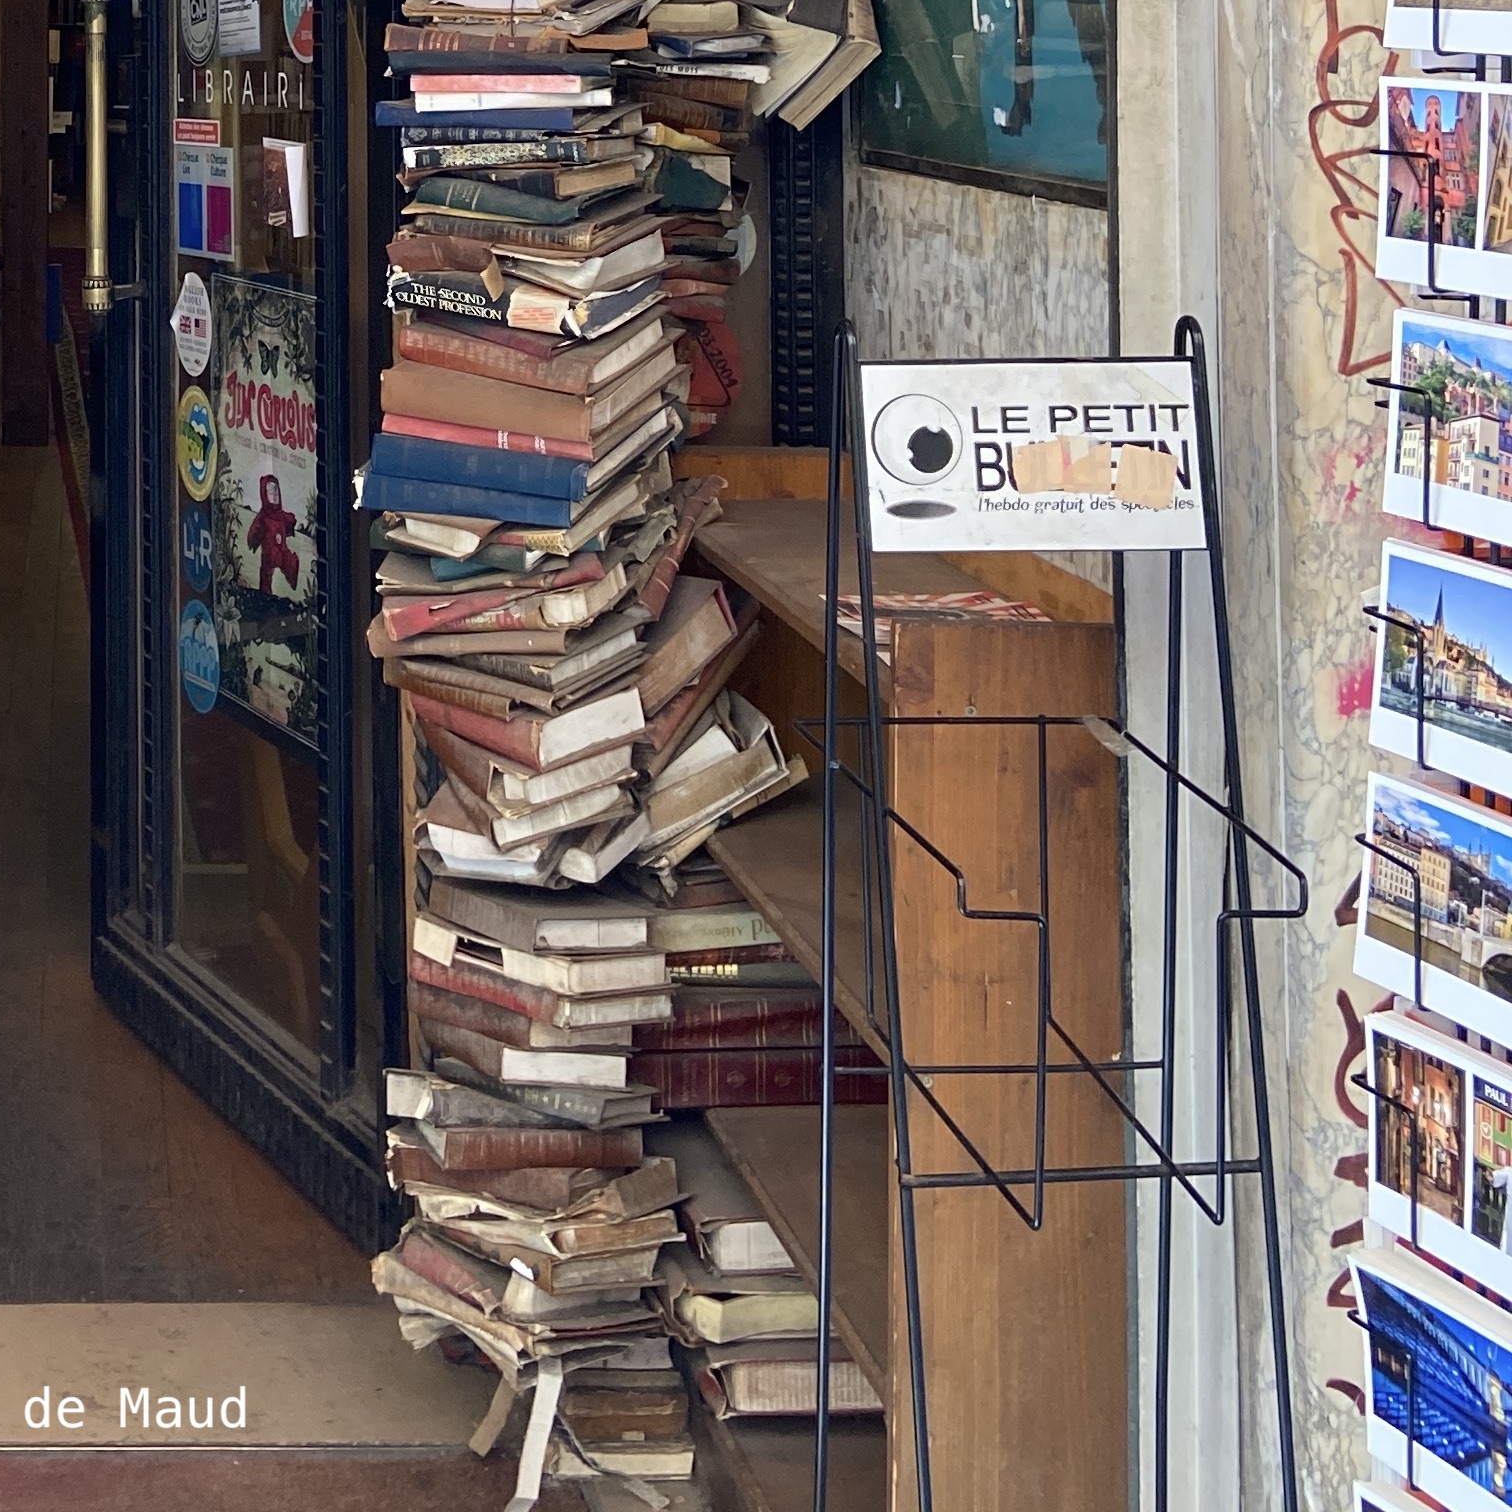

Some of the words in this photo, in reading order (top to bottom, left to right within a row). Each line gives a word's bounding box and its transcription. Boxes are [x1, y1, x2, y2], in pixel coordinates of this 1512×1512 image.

[395, 289, 437, 310] OLDEST
[438, 295, 503, 321] PROFESSION
[410, 281, 438, 298] THE
[437, 285, 486, 307] SECOND
[971, 405, 1031, 434] LE
[1049, 403, 1190, 434] PETIT
[978, 495, 1029, 512] l'hebdo
[1034, 495, 1084, 514] gratuit
[1090, 495, 1116, 511] des
[1484, 1083, 1509, 1107] PAUL
